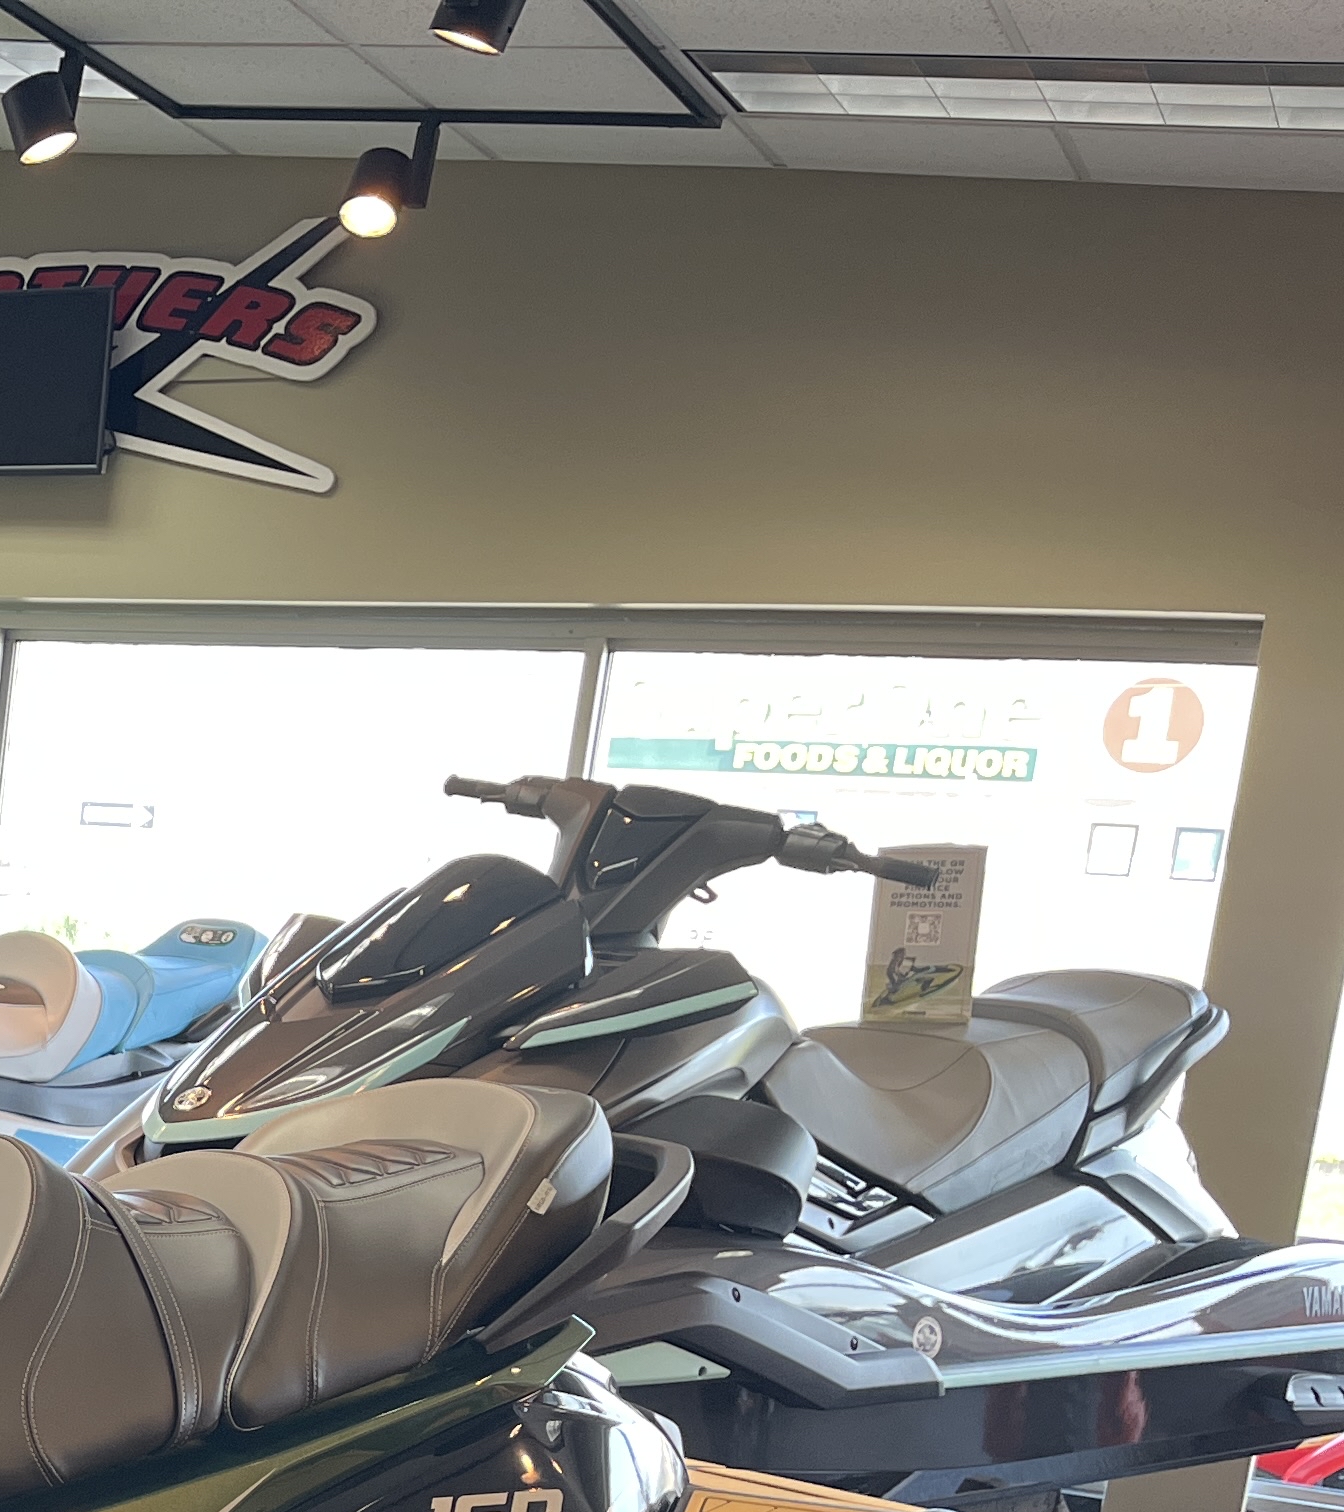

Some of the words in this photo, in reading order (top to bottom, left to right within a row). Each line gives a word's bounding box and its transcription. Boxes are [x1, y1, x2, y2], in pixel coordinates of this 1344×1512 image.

[1123, 686, 1180, 765] 1
[733, 742, 861, 773] FOODS
[862, 746, 889, 775] &
[892, 747, 1031, 779] LIQUOR
[891, 892, 937, 900] OPTIONS
[940, 892, 963, 900] AND
[1302, 1285, 1344, 1318] YAMA
